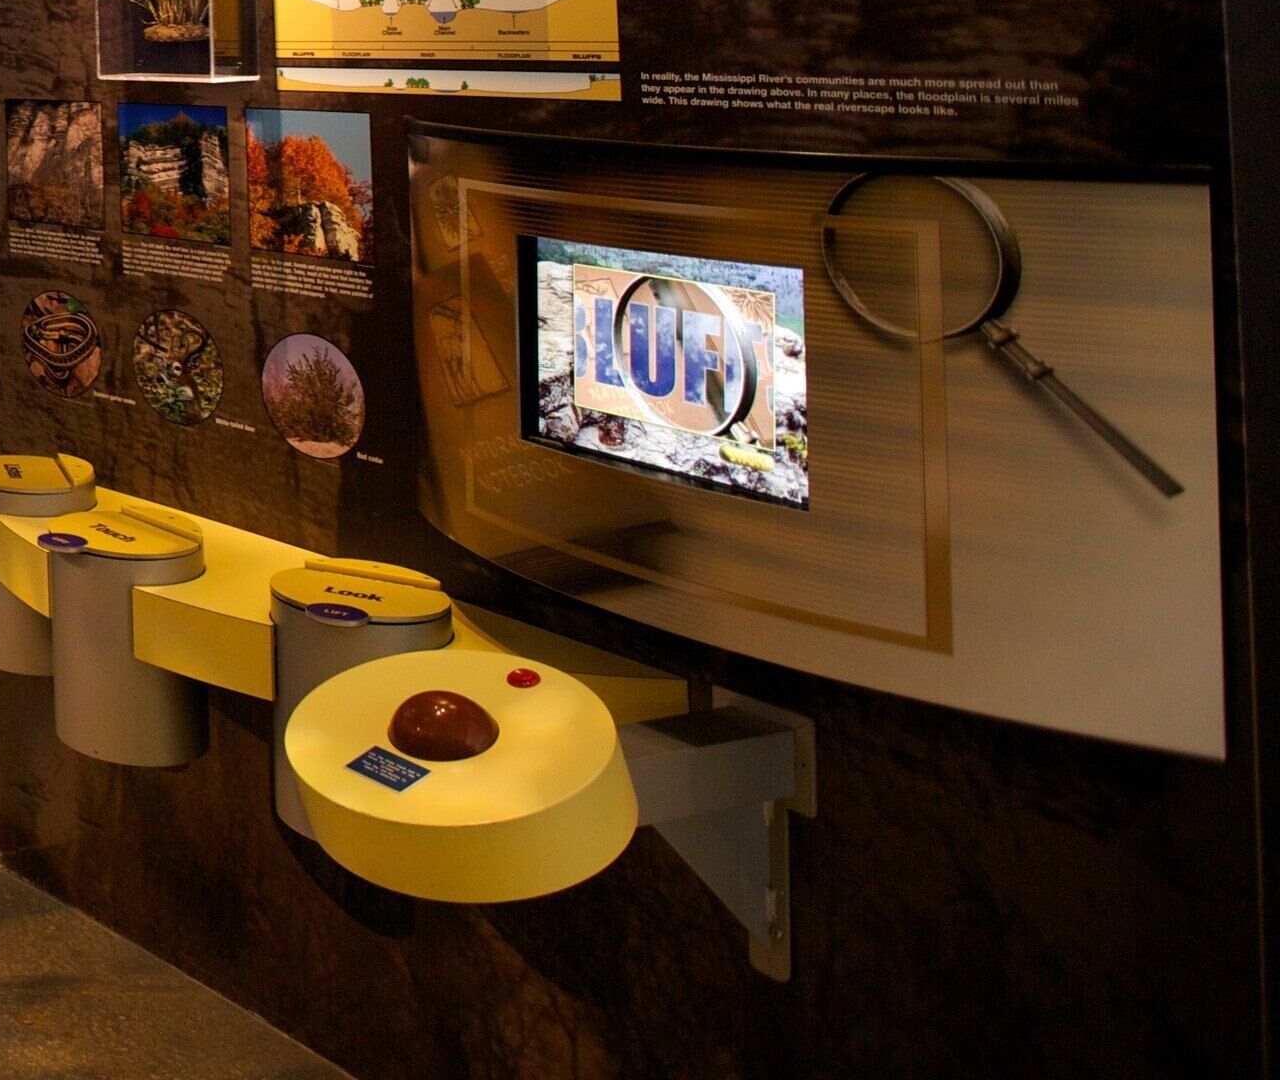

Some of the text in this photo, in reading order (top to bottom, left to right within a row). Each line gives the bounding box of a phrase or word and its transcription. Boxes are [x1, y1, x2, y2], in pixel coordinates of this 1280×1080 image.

[640, 71, 1058, 90] In reality, the Mississippi River's communities are much more spread out than
[89, 523, 136, 543] Touch
[324, 586, 384, 603] Look
[323, 608, 349, 617] LIFT
